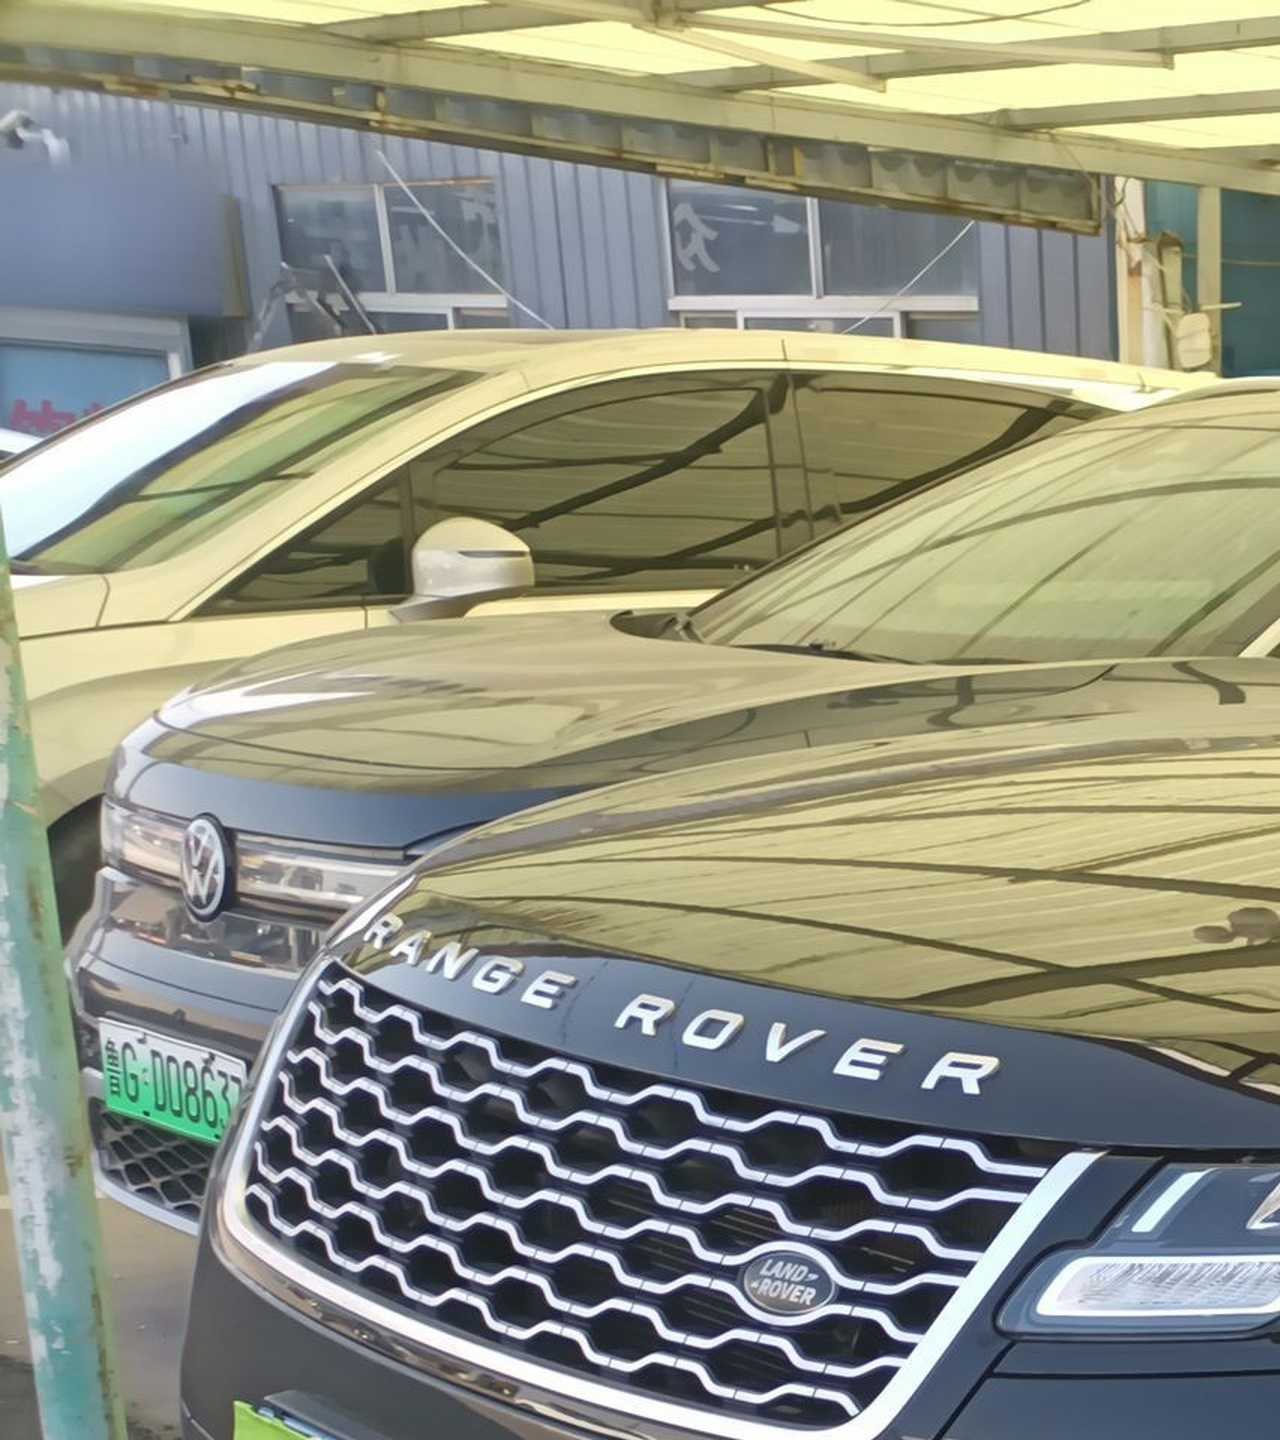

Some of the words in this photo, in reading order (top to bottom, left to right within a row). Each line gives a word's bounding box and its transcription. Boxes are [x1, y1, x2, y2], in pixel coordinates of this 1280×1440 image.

[363, 912, 576, 1010] RANGE
[614, 993, 1001, 1095] ROVER
[758, 1278, 816, 1305] ROVER
